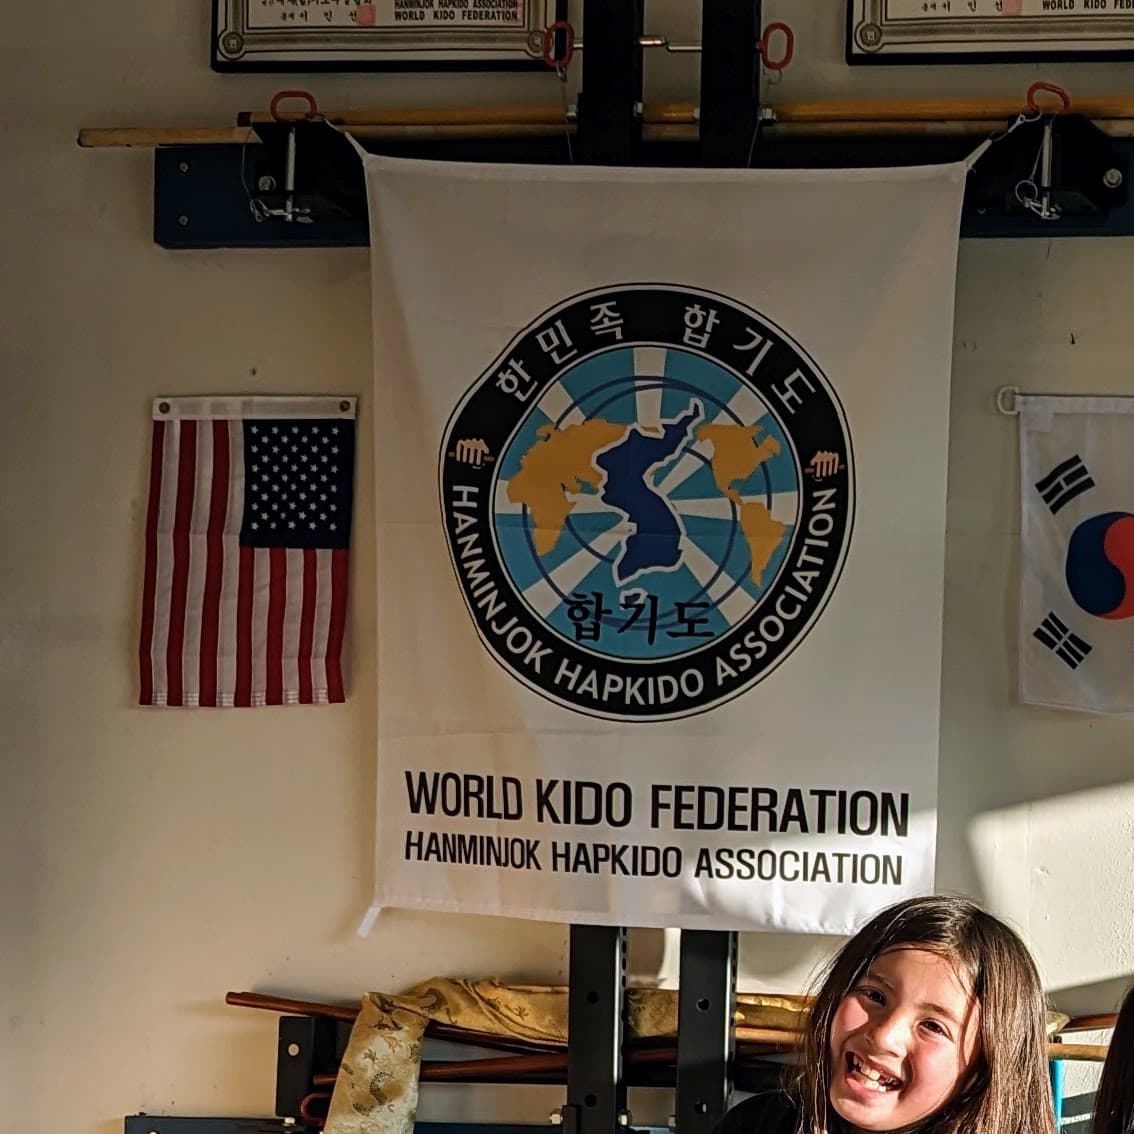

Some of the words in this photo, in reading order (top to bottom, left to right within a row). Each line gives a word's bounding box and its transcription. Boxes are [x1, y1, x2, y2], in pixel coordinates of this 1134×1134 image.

[394, 10, 425, 21] WORLD
[433, 10, 456, 20] KIDO
[462, 10, 518, 21] FEDERATION
[1042, 0, 1075, 10] WORLD
[1083, 0, 1107, 9] KIDO
[496, 301, 624, 402] 한민족
[682, 304, 816, 414] 합기도
[452, 484, 555, 675] HANMINJOK
[554, 659, 704, 706] HAPKIDO
[716, 488, 838, 686] ASSOCIATION
[566, 591, 716, 645] 합기도
[405, 770, 524, 821] WORLD
[536, 778, 633, 829] KIDO
[651, 785, 910, 837] FEDERATION
[404, 830, 542, 871] HANMINJOK
[552, 840, 683, 879] HAPKIDO
[694, 848, 903, 885] ASSOCIATION
